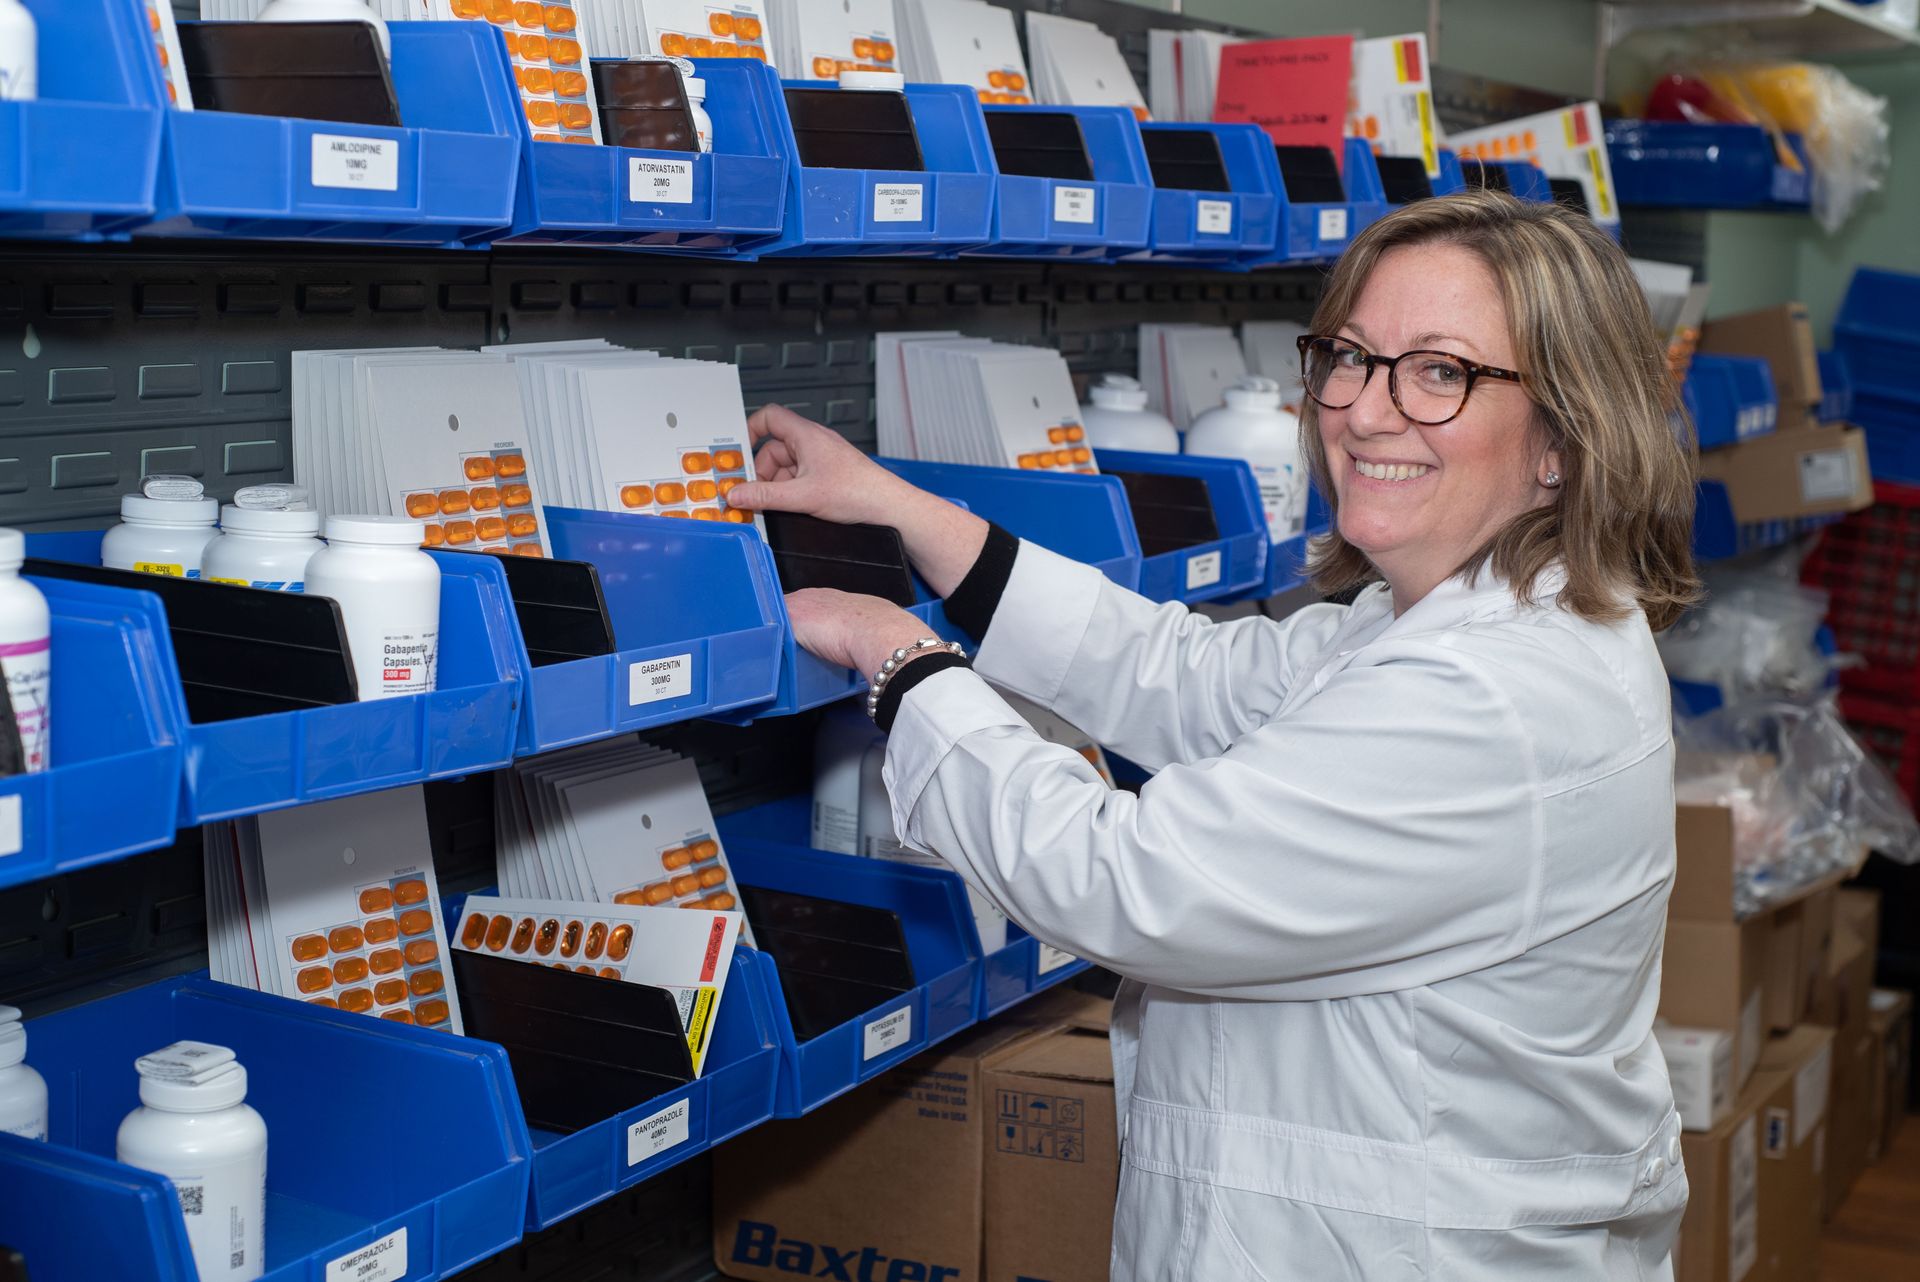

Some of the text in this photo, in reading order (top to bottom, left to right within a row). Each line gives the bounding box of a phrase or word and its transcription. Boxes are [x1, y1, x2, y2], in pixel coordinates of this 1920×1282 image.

[331, 141, 382, 155] AMLODIPINE
[345, 158, 367, 169] 10MG
[638, 163, 685, 174] ATORVASTATIN
[653, 178, 670, 187] 20MG
[384, 643, 427, 655] Gabapentin
[383, 656, 422, 668] Capsules,
[641, 660, 681, 675] GABAPENTIN
[399, 671, 410, 679] mg
[651, 674, 671, 685] 300MG
[635, 1107, 683, 1136] PANTOPRAZOLE
[651, 1126, 667, 1139] 40MG
[340, 1238, 394, 1272] OMEPRAZOLE
[732, 1220, 960, 1282] Baxter
[357, 1259, 378, 1277] 20MG
